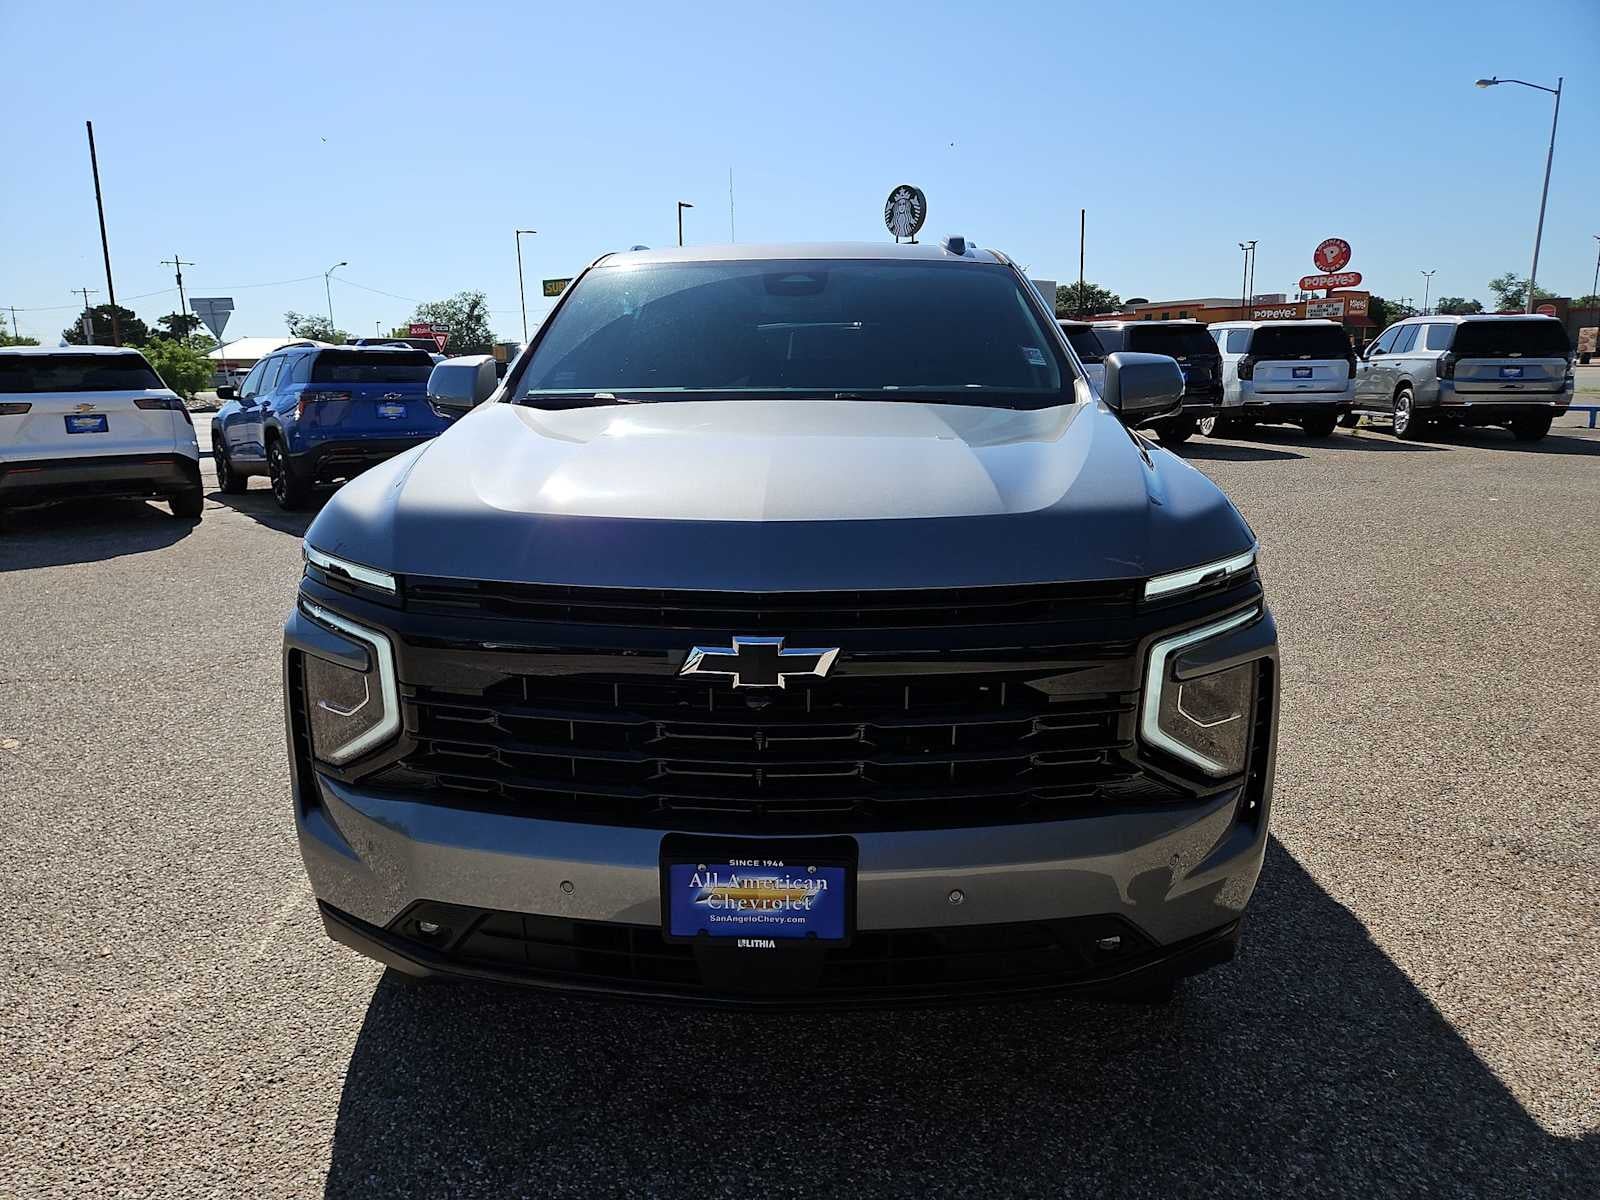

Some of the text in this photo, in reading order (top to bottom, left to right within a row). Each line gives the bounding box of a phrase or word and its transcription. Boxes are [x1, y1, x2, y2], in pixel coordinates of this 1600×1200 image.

[729, 859, 784, 867] SINCE 1946
[689, 872, 828, 890] All American
[707, 893, 813, 911] Chevrolet
[710, 915, 806, 924] SanAngeloChevy.com
